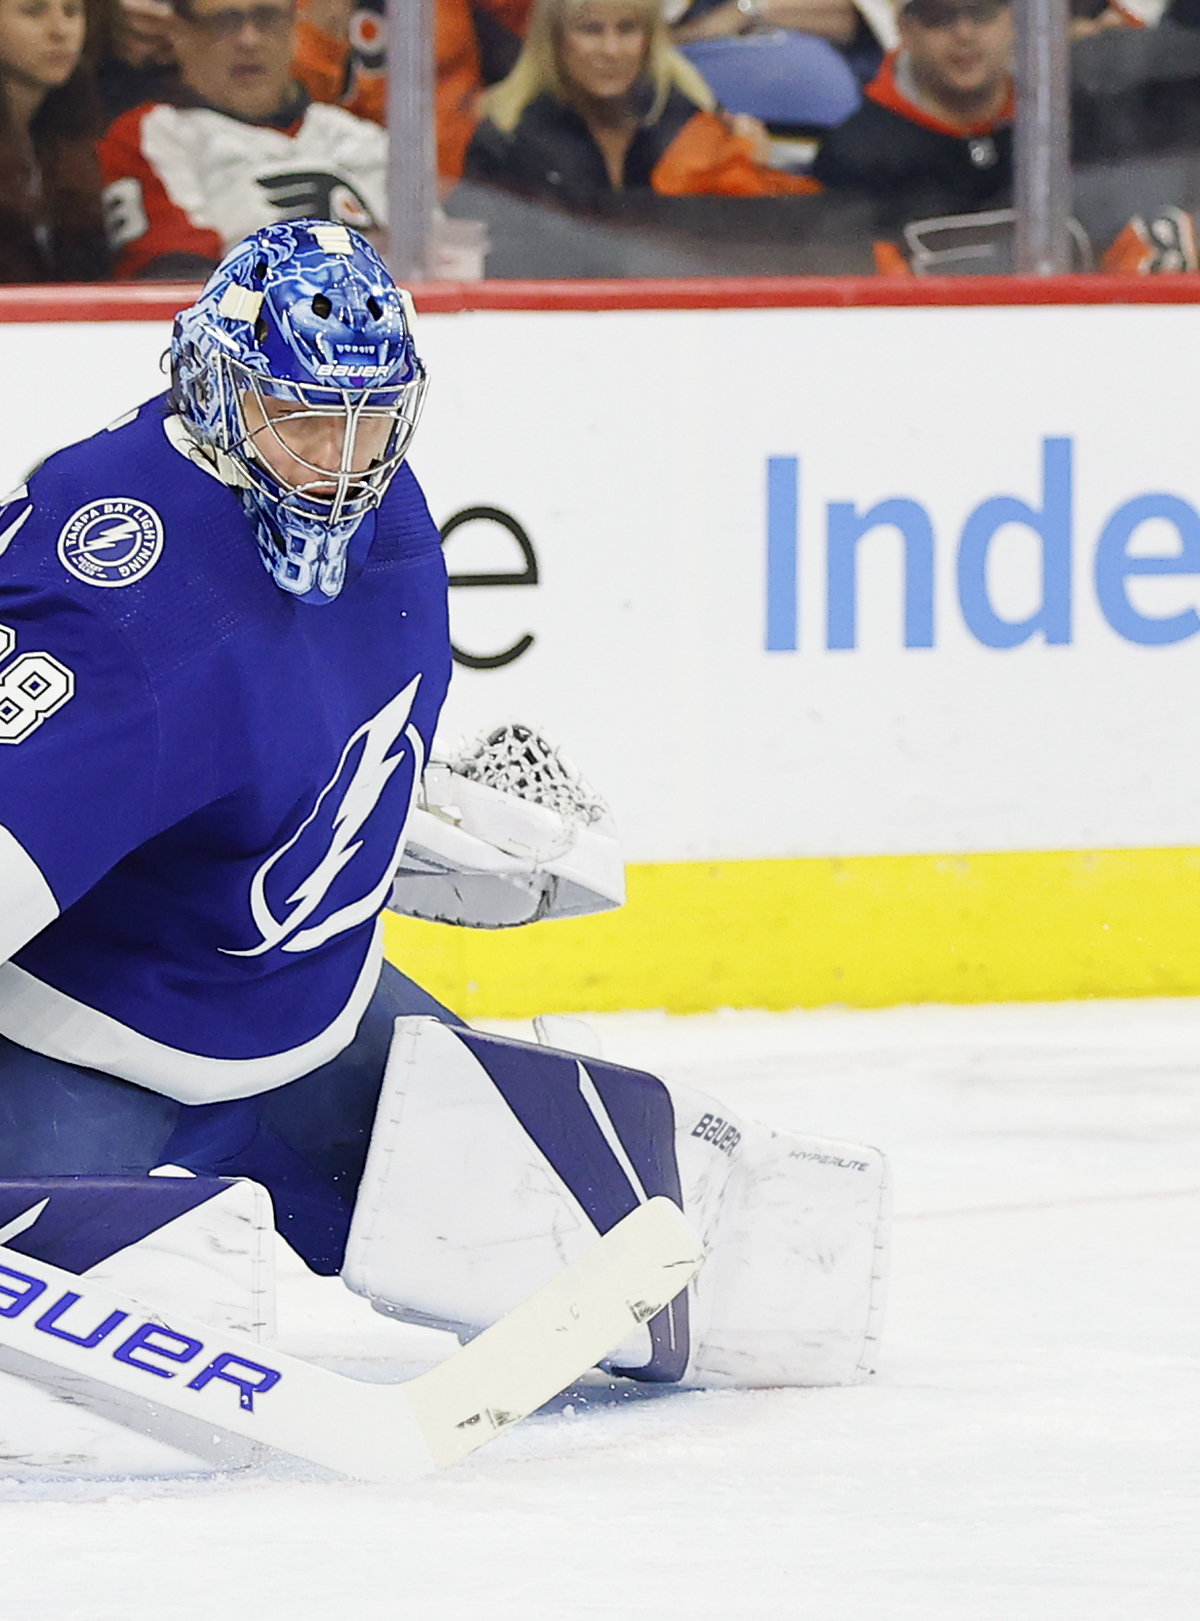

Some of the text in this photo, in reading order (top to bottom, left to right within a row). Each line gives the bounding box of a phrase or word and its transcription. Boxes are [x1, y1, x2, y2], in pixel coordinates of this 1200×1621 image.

[315, 363, 393, 379] BAUER
[65, 508, 100, 547] TAMPA
[103, 503, 134, 515] BAY
[117, 508, 157, 578] LIGHTNING
[765, 436, 1200, 651] Inde
[689, 1112, 742, 1158] BAUER
[787, 1149, 870, 1173] HYPERLITE
